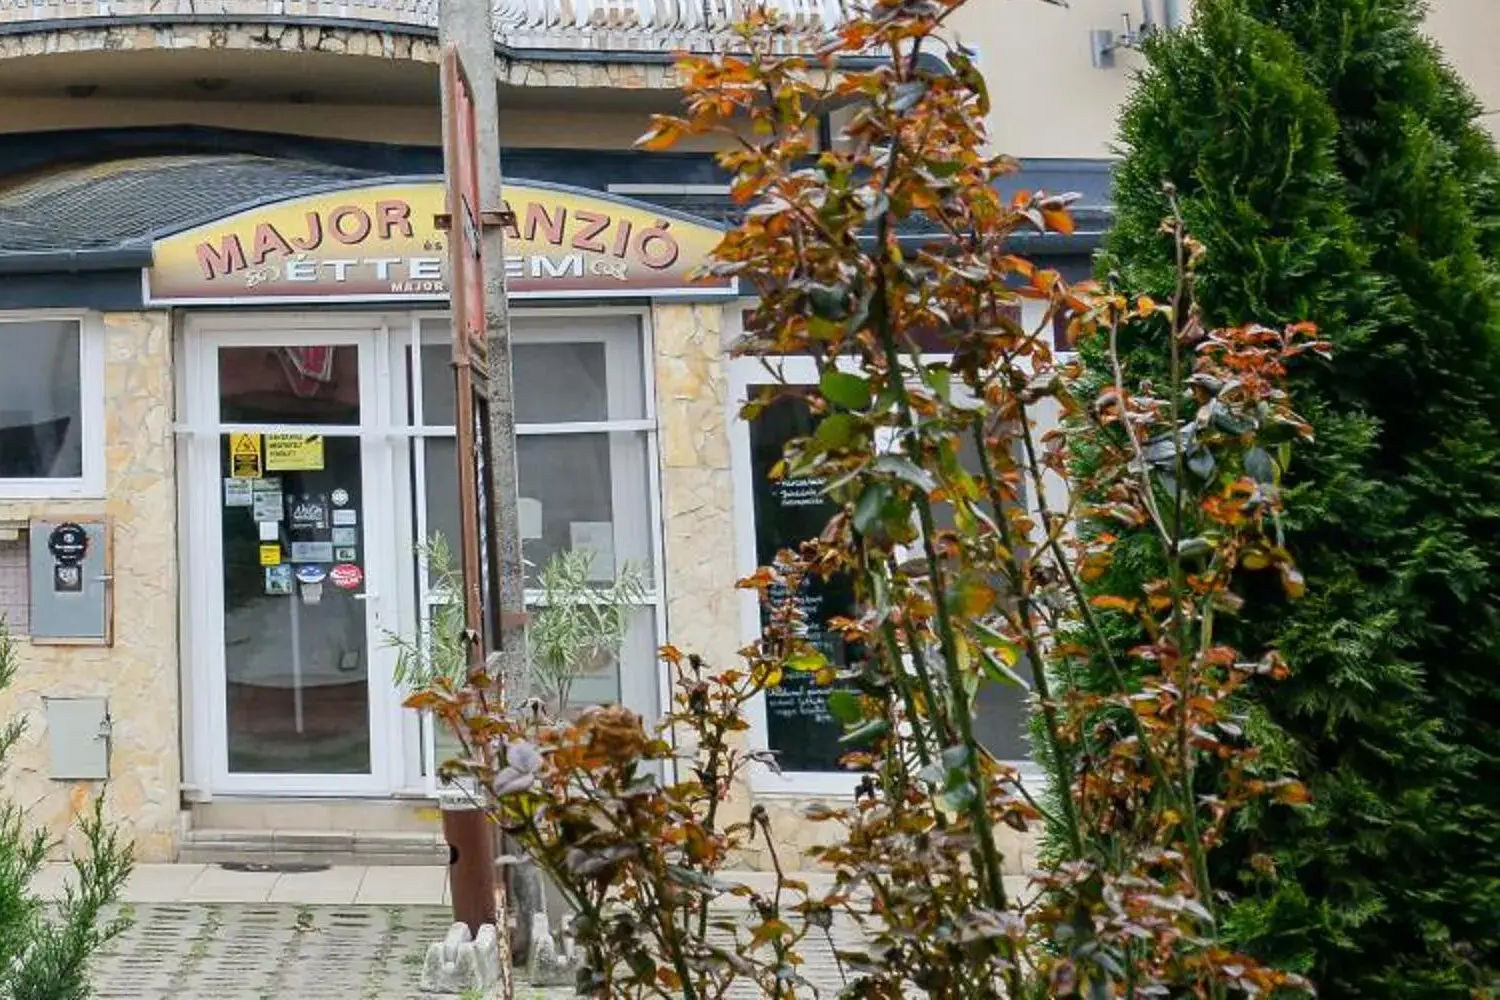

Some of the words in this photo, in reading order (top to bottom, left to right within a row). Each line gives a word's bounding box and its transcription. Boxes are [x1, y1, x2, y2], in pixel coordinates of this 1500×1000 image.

[195, 199, 414, 281] MAJOR
[446, 196, 679, 270] NZIÓ
[285, 252, 585, 283] ÉTTEEM
[390, 280, 445, 294] MAJOR
